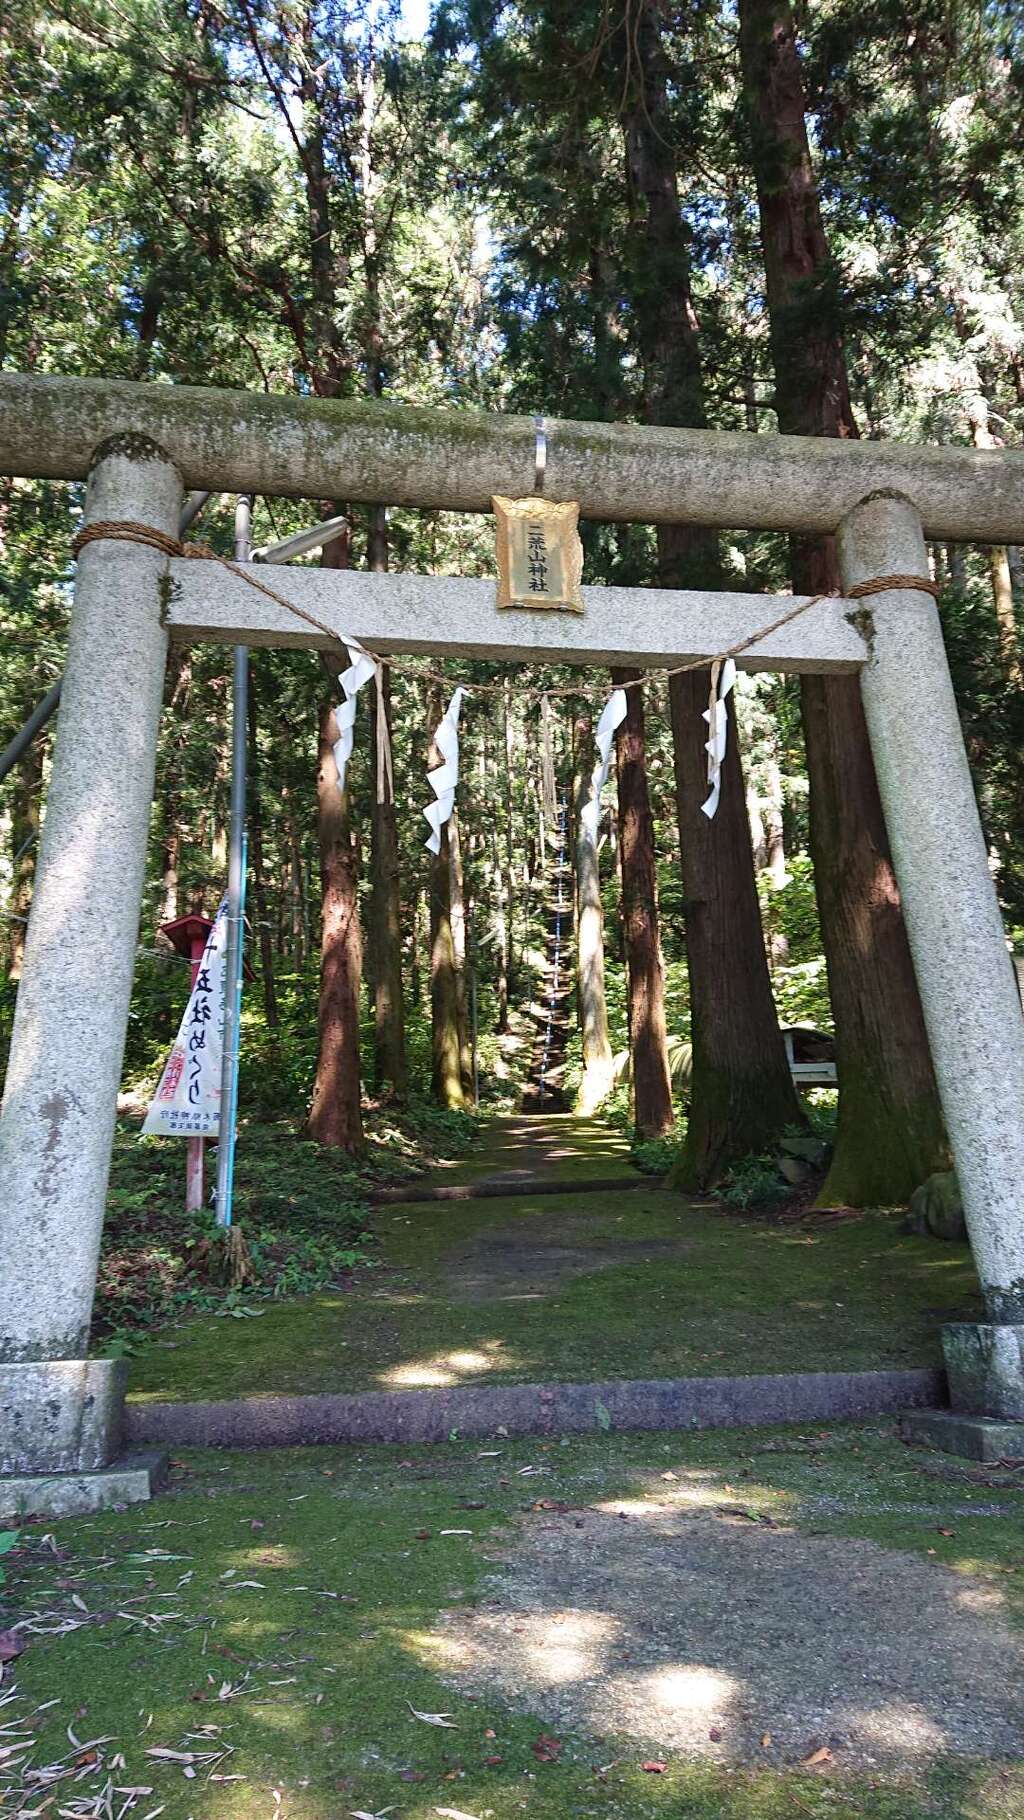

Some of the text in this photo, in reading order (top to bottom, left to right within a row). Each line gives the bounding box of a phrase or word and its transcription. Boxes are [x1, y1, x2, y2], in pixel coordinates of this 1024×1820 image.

[527, 525, 549, 593] 二荒山神社
